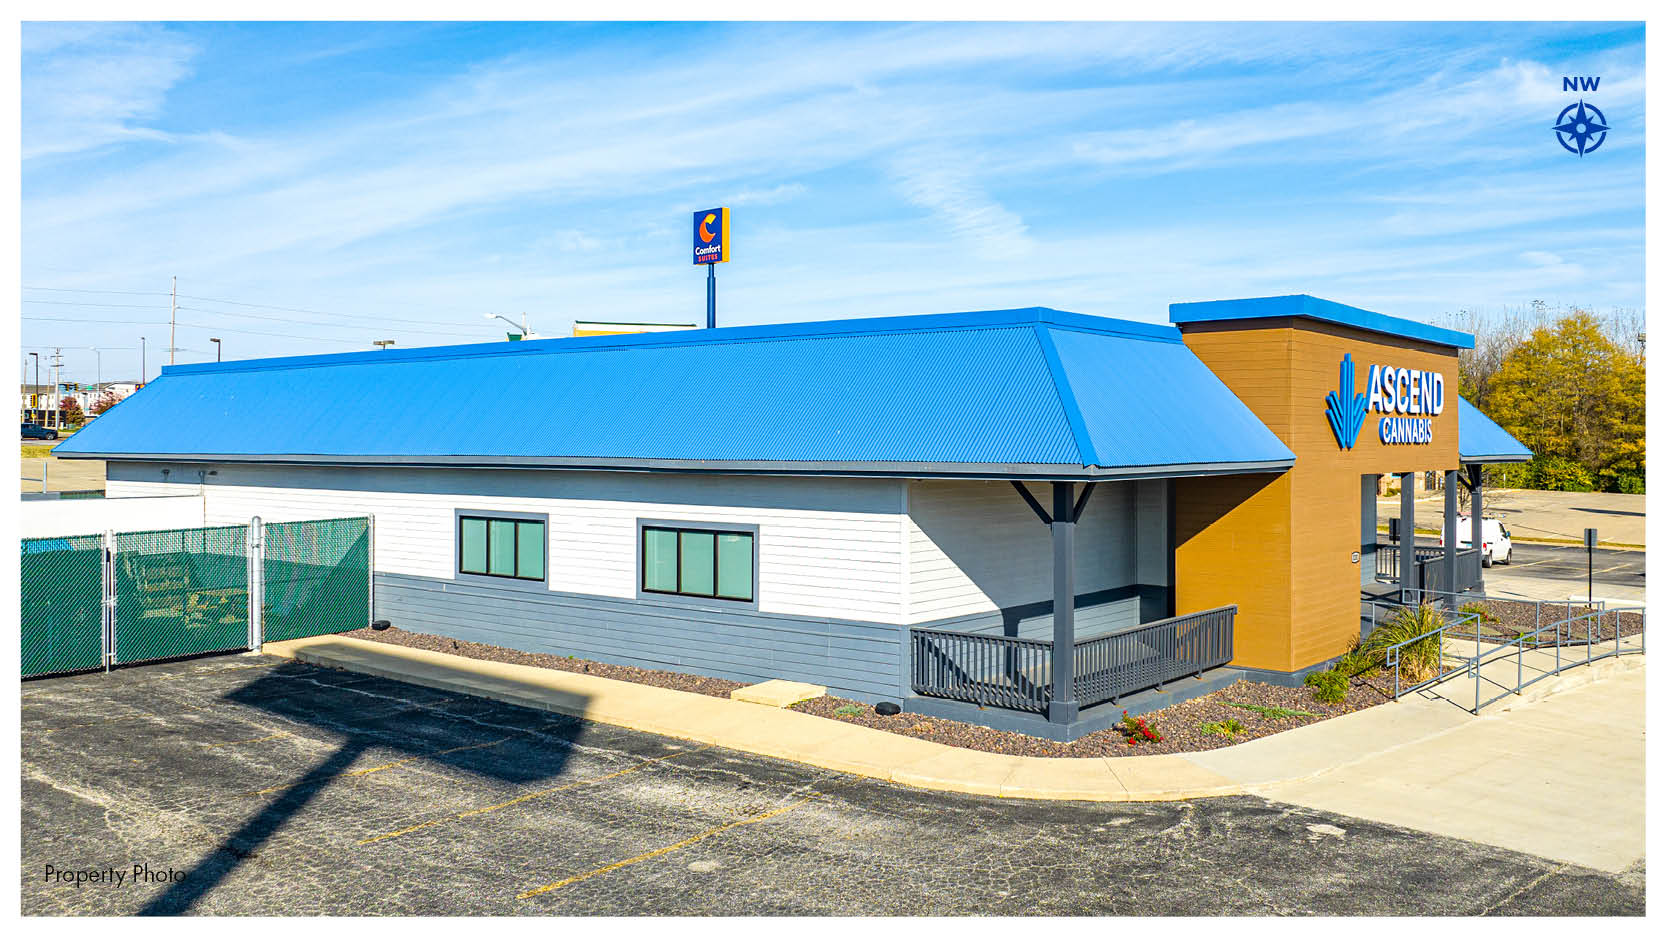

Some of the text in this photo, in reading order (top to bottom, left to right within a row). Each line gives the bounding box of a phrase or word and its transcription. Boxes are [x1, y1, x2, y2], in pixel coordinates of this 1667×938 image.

[695, 244, 721, 256] Comfort
[698, 253, 718, 262] SUITES
[1366, 364, 1445, 416] ASCEND
[1379, 416, 1433, 445] CANNABIS
